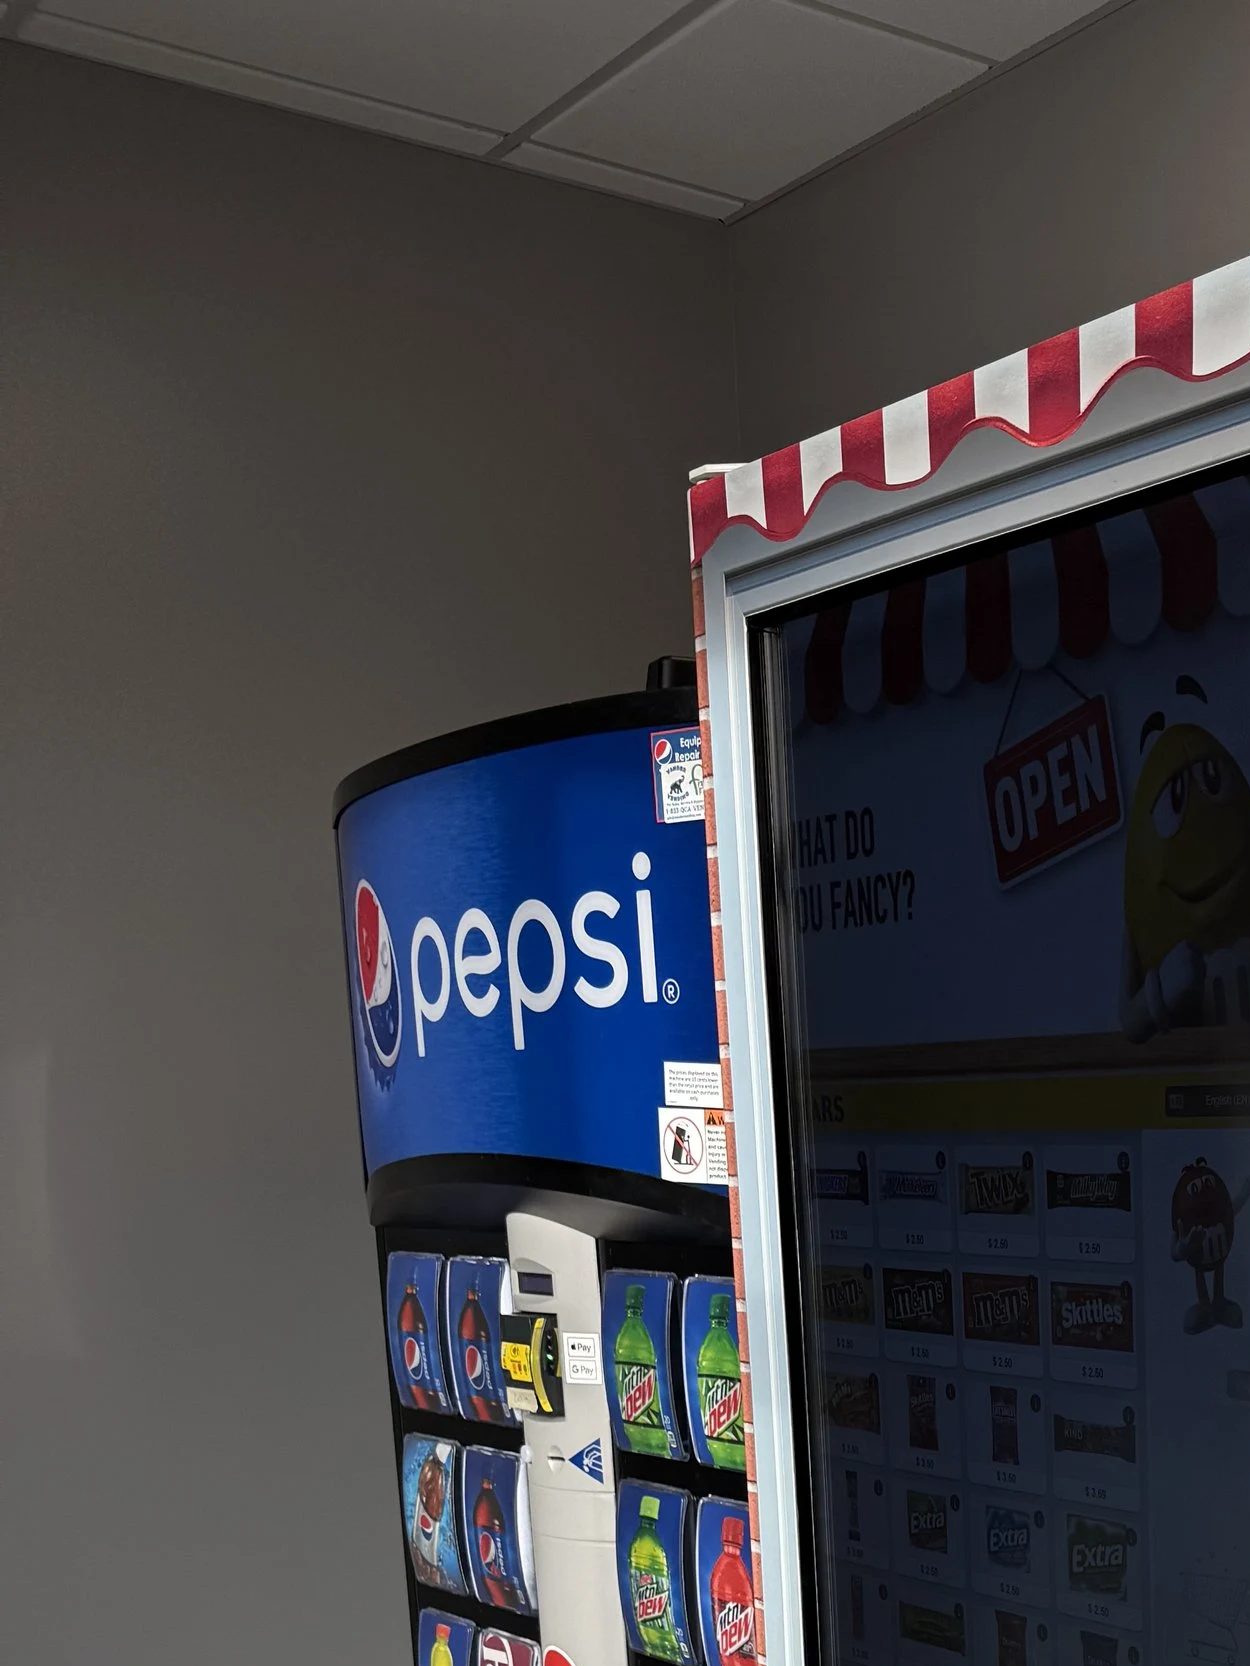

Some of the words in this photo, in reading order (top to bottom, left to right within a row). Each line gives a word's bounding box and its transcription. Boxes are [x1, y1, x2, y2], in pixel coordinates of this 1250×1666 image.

[994, 723, 1106, 852] OPEN
[845, 806, 875, 860] DO
[796, 883, 823, 935] OU
[829, 869, 915, 930] FANCY?
[411, 851, 658, 1057] pepsi
[1061, 1298, 1123, 1329] Skittles
[577, 1343, 592, 1353] Pay
[580, 1365, 594, 1376] Pay
[910, 1511, 945, 1534] Extra
[990, 1528, 1027, 1551] Extra
[1072, 1543, 1123, 1573] Extra
